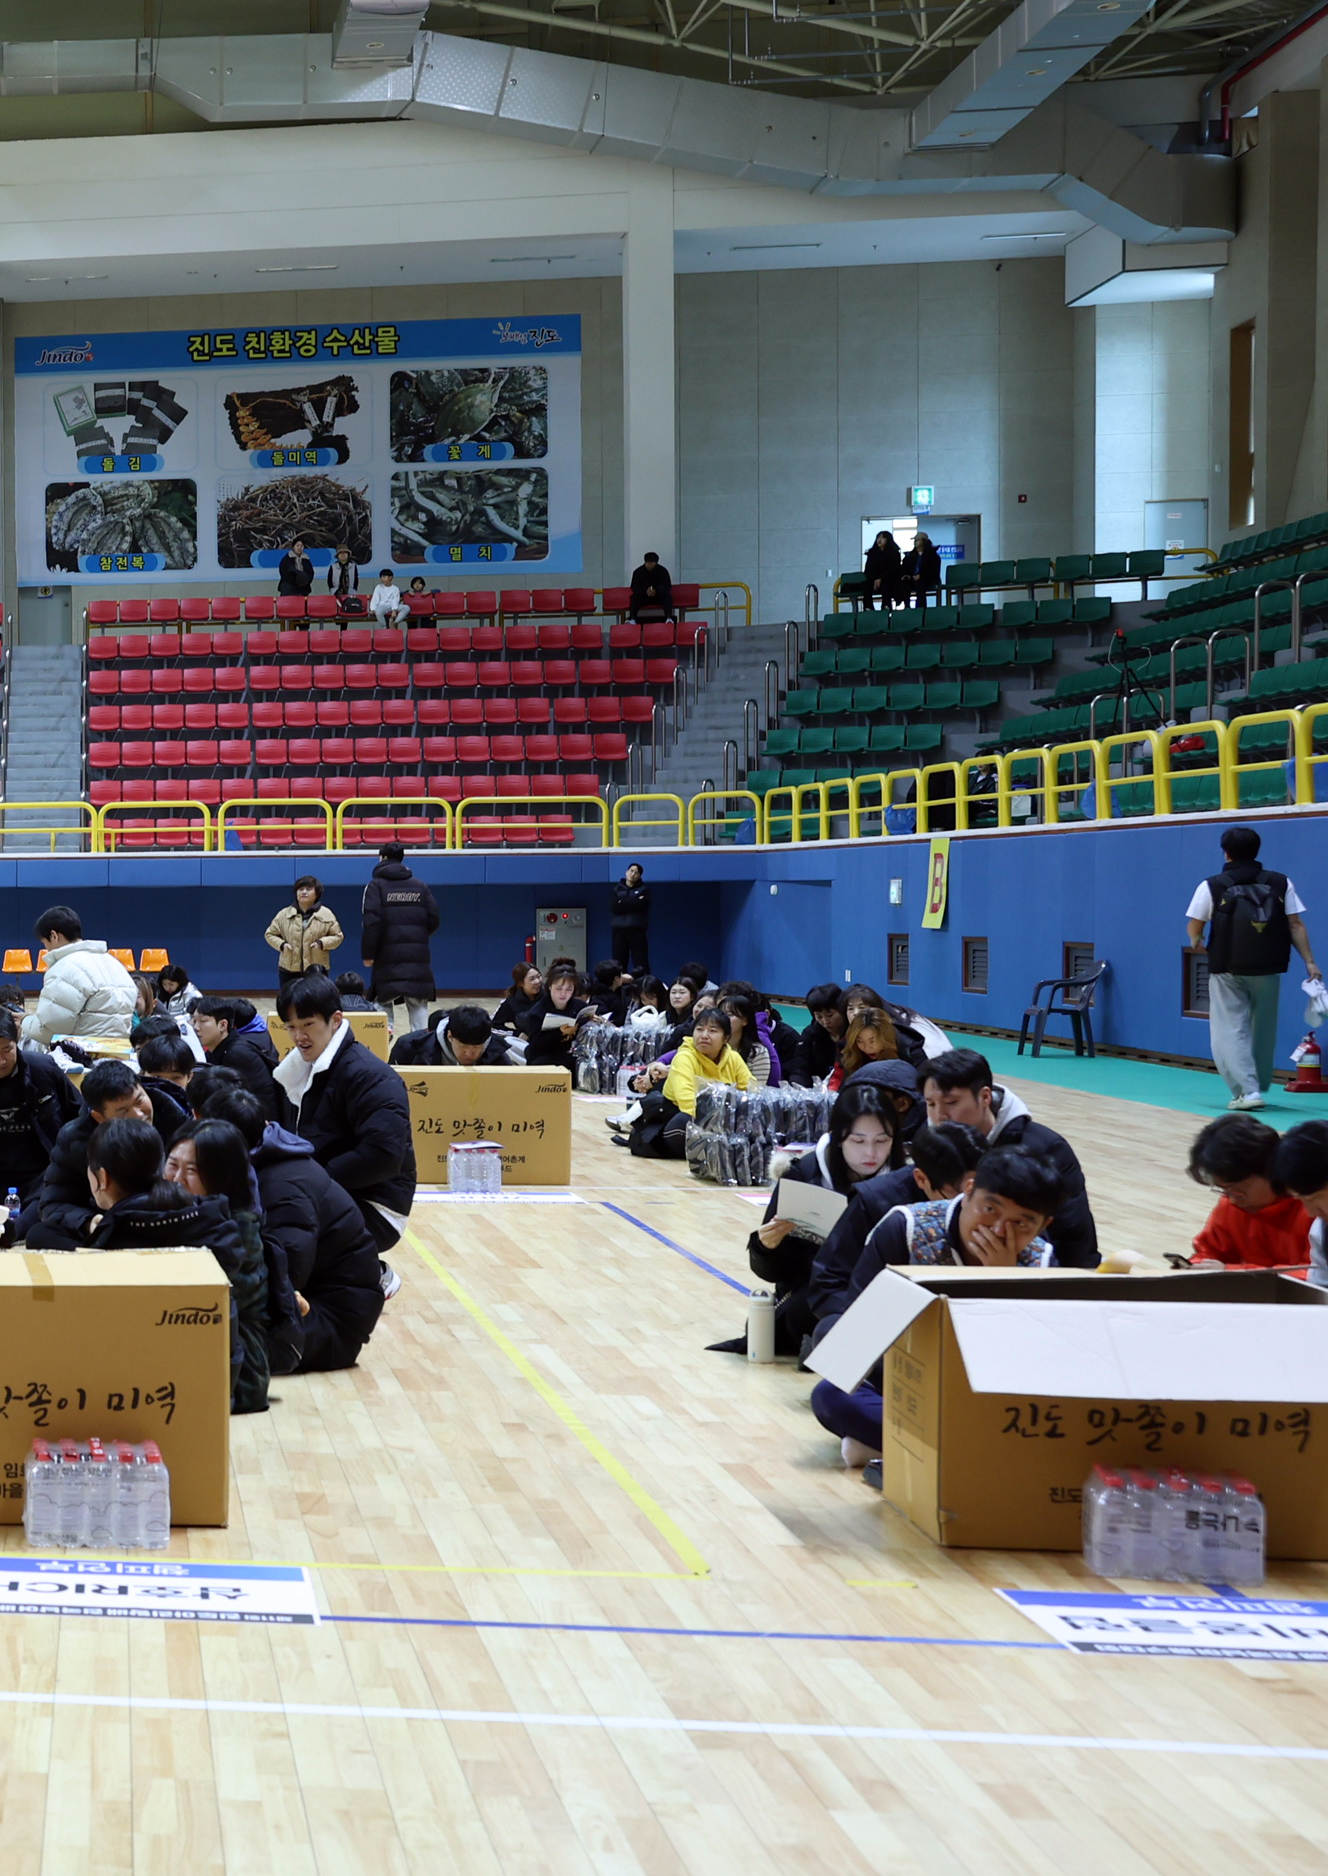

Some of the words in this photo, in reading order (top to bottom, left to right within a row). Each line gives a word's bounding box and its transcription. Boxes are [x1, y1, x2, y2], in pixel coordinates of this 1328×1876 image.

[188, 334, 238, 362] 진도
[243, 329, 317, 359] 친환경
[322, 327, 399, 356] 수산물
[528, 327, 562, 348] 진도
[35, 346, 87, 366] Jindo
[272, 450, 317, 466] 돌미역
[447, 445, 491, 460] 꽃게
[101, 457, 141, 472] 돌김
[98, 554, 146, 571] 참전복
[449, 545, 492, 561] 멸치
[930, 853, 944, 914] B
[535, 1084, 561, 1094] Jindo
[417, 1118, 445, 1134] 진도
[511, 1119, 545, 1139] 미역
[150, 1218, 178, 1227] NORTH
[155, 1307, 212, 1327] Jindo
[107, 1381, 177, 1425] 미역
[1002, 1403, 1066, 1439] 진도
[1229, 1406, 1313, 1454] 미역
